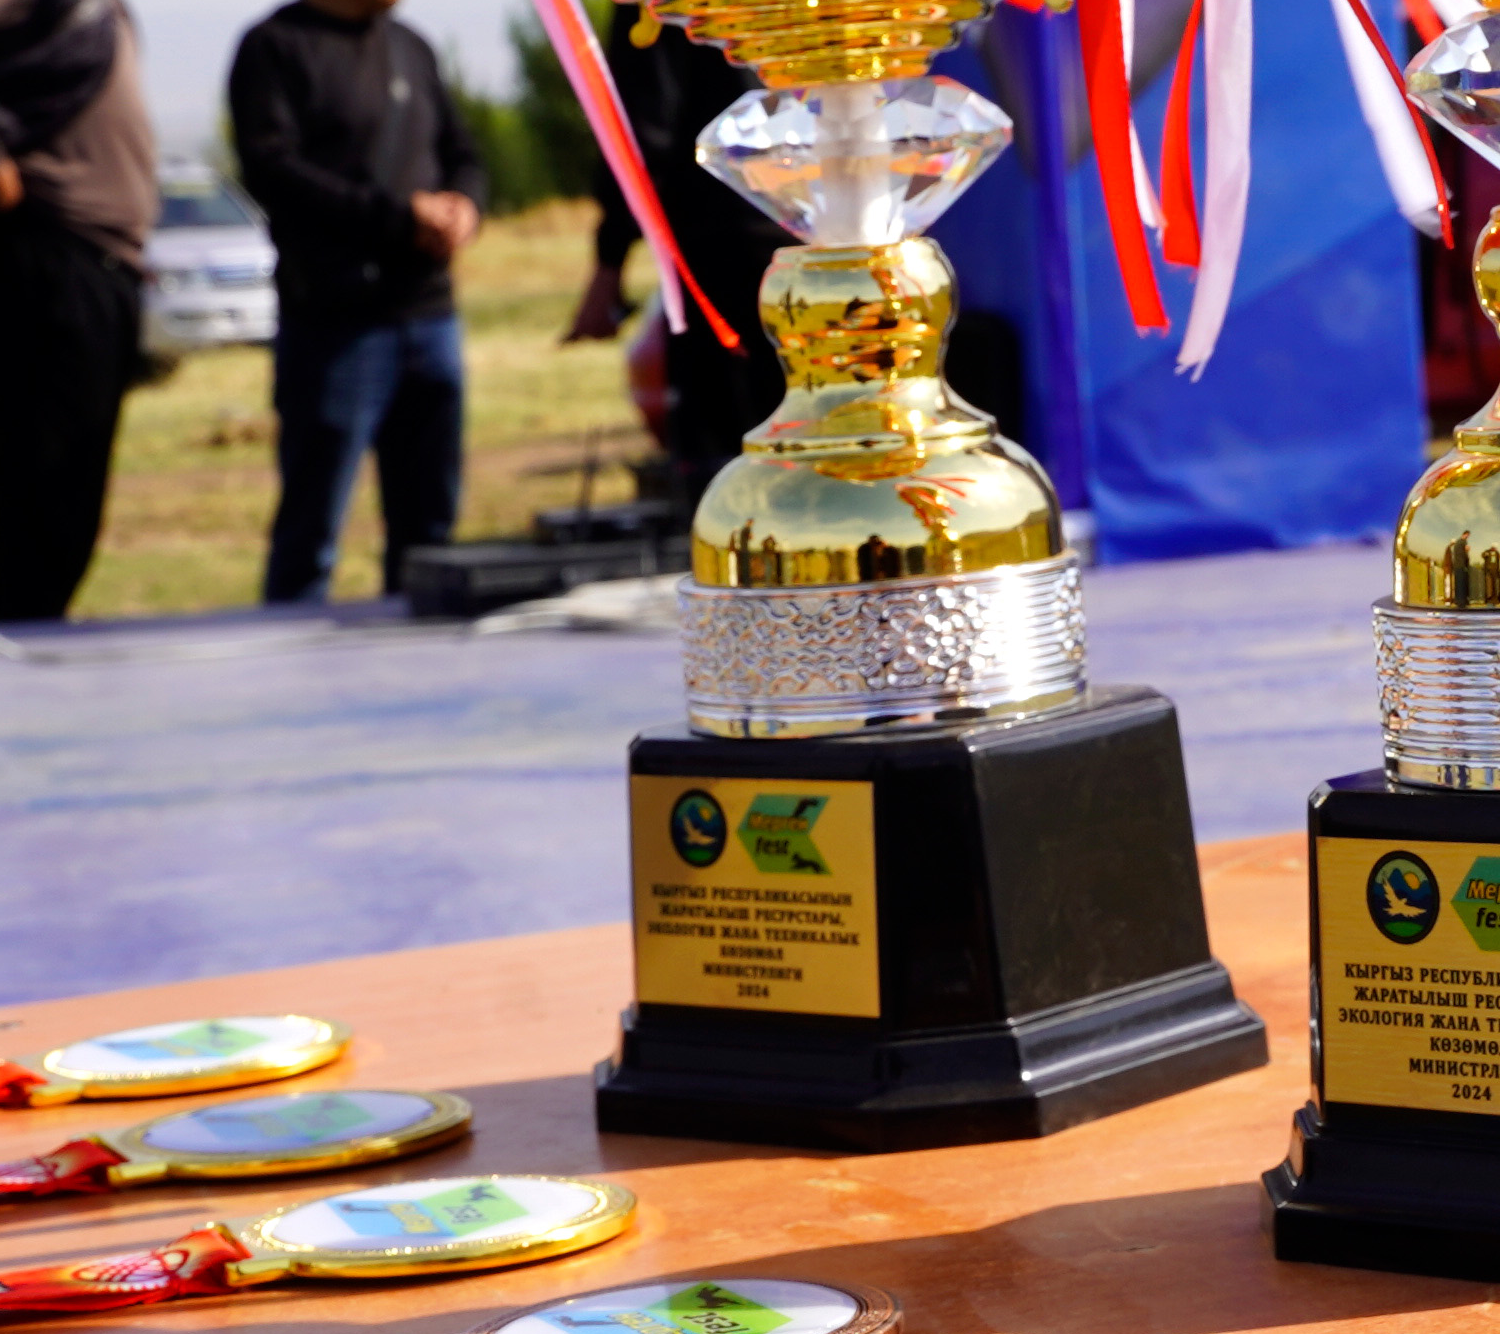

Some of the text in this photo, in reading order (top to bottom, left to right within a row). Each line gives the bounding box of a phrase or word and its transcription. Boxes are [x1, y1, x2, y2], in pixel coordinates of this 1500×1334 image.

[1344, 963, 1414, 982] КЫРГЫЗ
[1354, 987, 1467, 1008] ЖАРАТЫЛЫШ
[1338, 1008, 1425, 1028] ЭКОЛОГИЯ
[1430, 1014, 1480, 1032] ЖАНА
[1452, 1084, 1492, 1101] 2024
